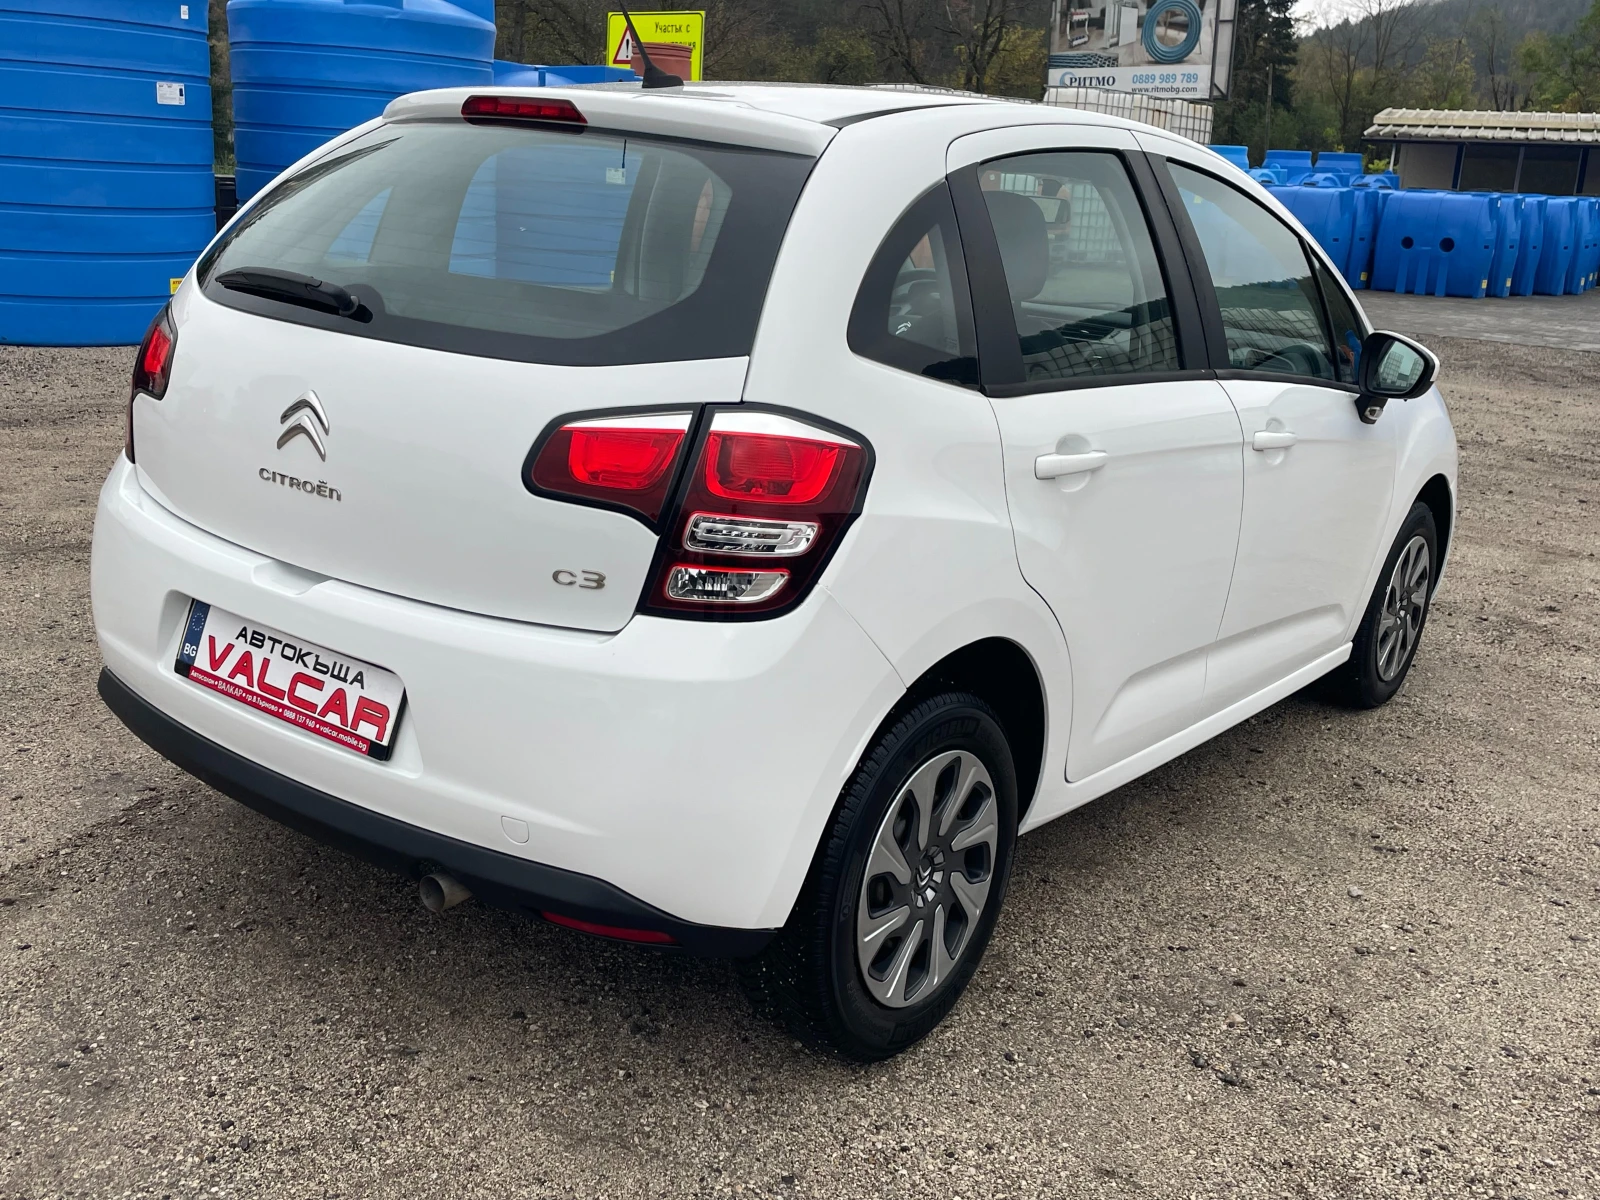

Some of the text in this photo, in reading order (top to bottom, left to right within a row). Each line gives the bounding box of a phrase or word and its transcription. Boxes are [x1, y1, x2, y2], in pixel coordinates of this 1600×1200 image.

[654, 21, 683, 34] Участък
[1069, 75, 1116, 87] РИТМО
[1132, 73, 1199, 84] 0889 989 789
[1131, 85, 1198, 95] www.ritmobg.com
[552, 569, 606, 590] C3
[183, 643, 197, 656] BG
[235, 625, 364, 690] АВТОКЪША
[208, 634, 390, 742] VALCAR
[190, 669, 215, 684] Автосалон
[217, 680, 244, 697] ВАЛКАР
[283, 710, 296, 720] 0888
[296, 714, 305, 723] 137
[305, 717, 316, 728] 960
[320, 724, 367, 751] valcar.mobile.bg
[914, 717, 980, 754] MICHELIN
